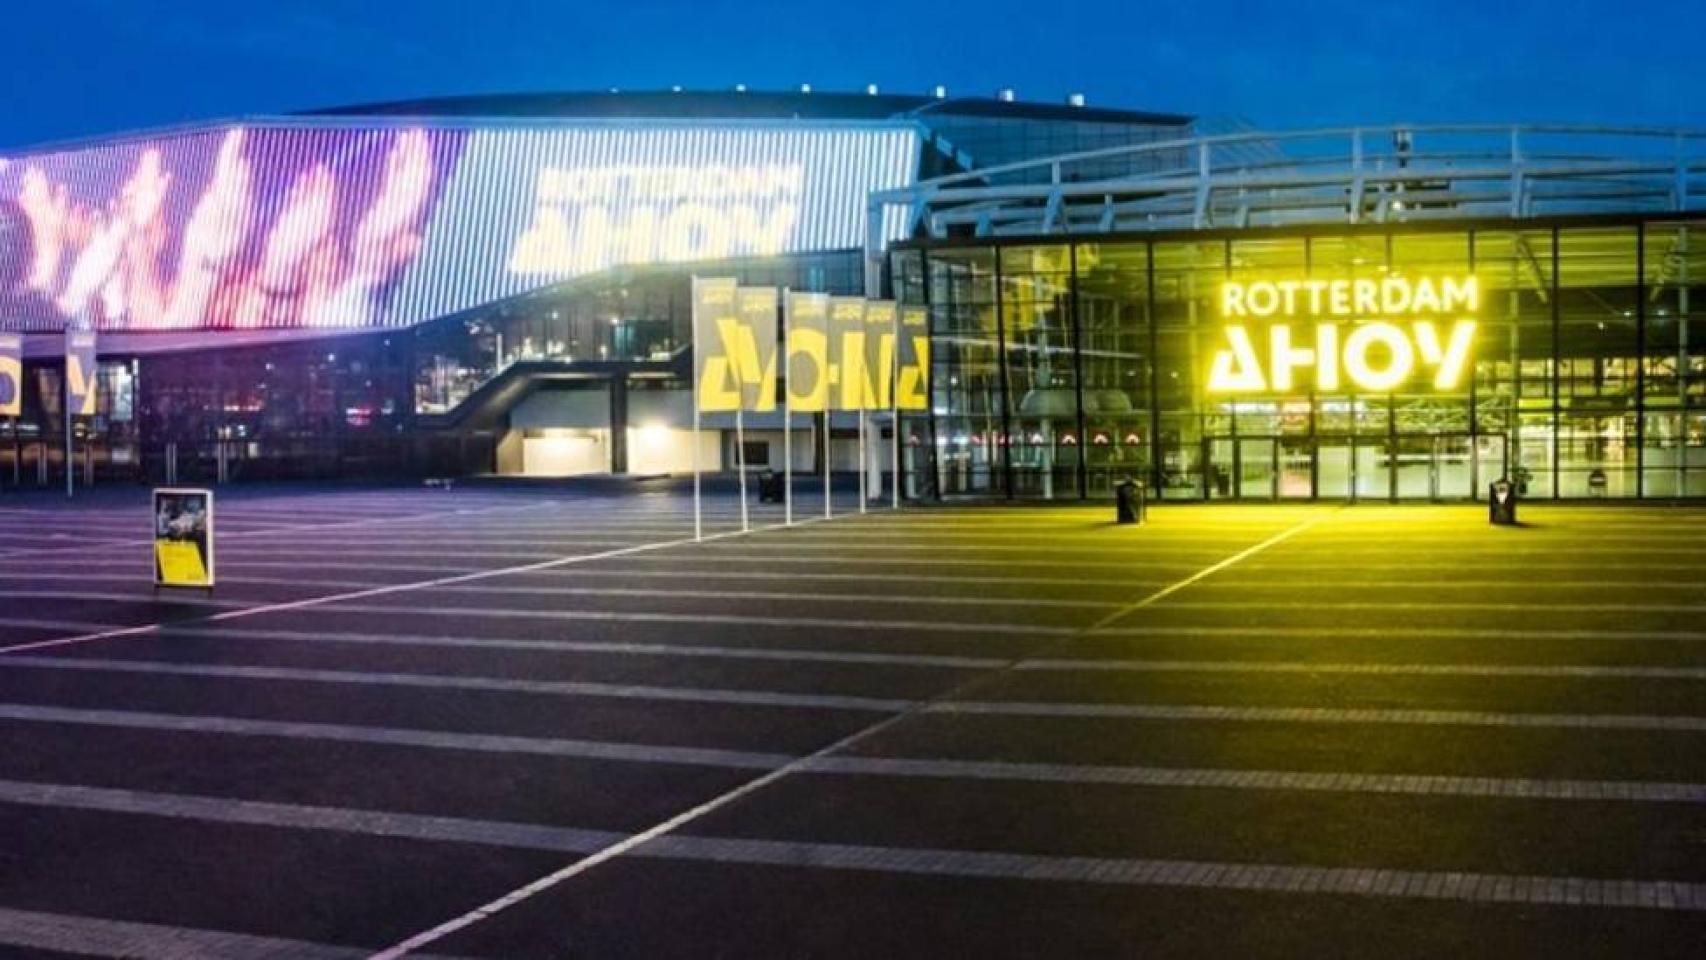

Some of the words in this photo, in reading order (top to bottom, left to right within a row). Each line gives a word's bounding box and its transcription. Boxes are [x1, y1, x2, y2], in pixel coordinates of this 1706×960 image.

[510, 202, 797, 272] AHOY
[1221, 275, 1478, 316] ROTTERDAM
[1207, 319, 1478, 391] AHOY
